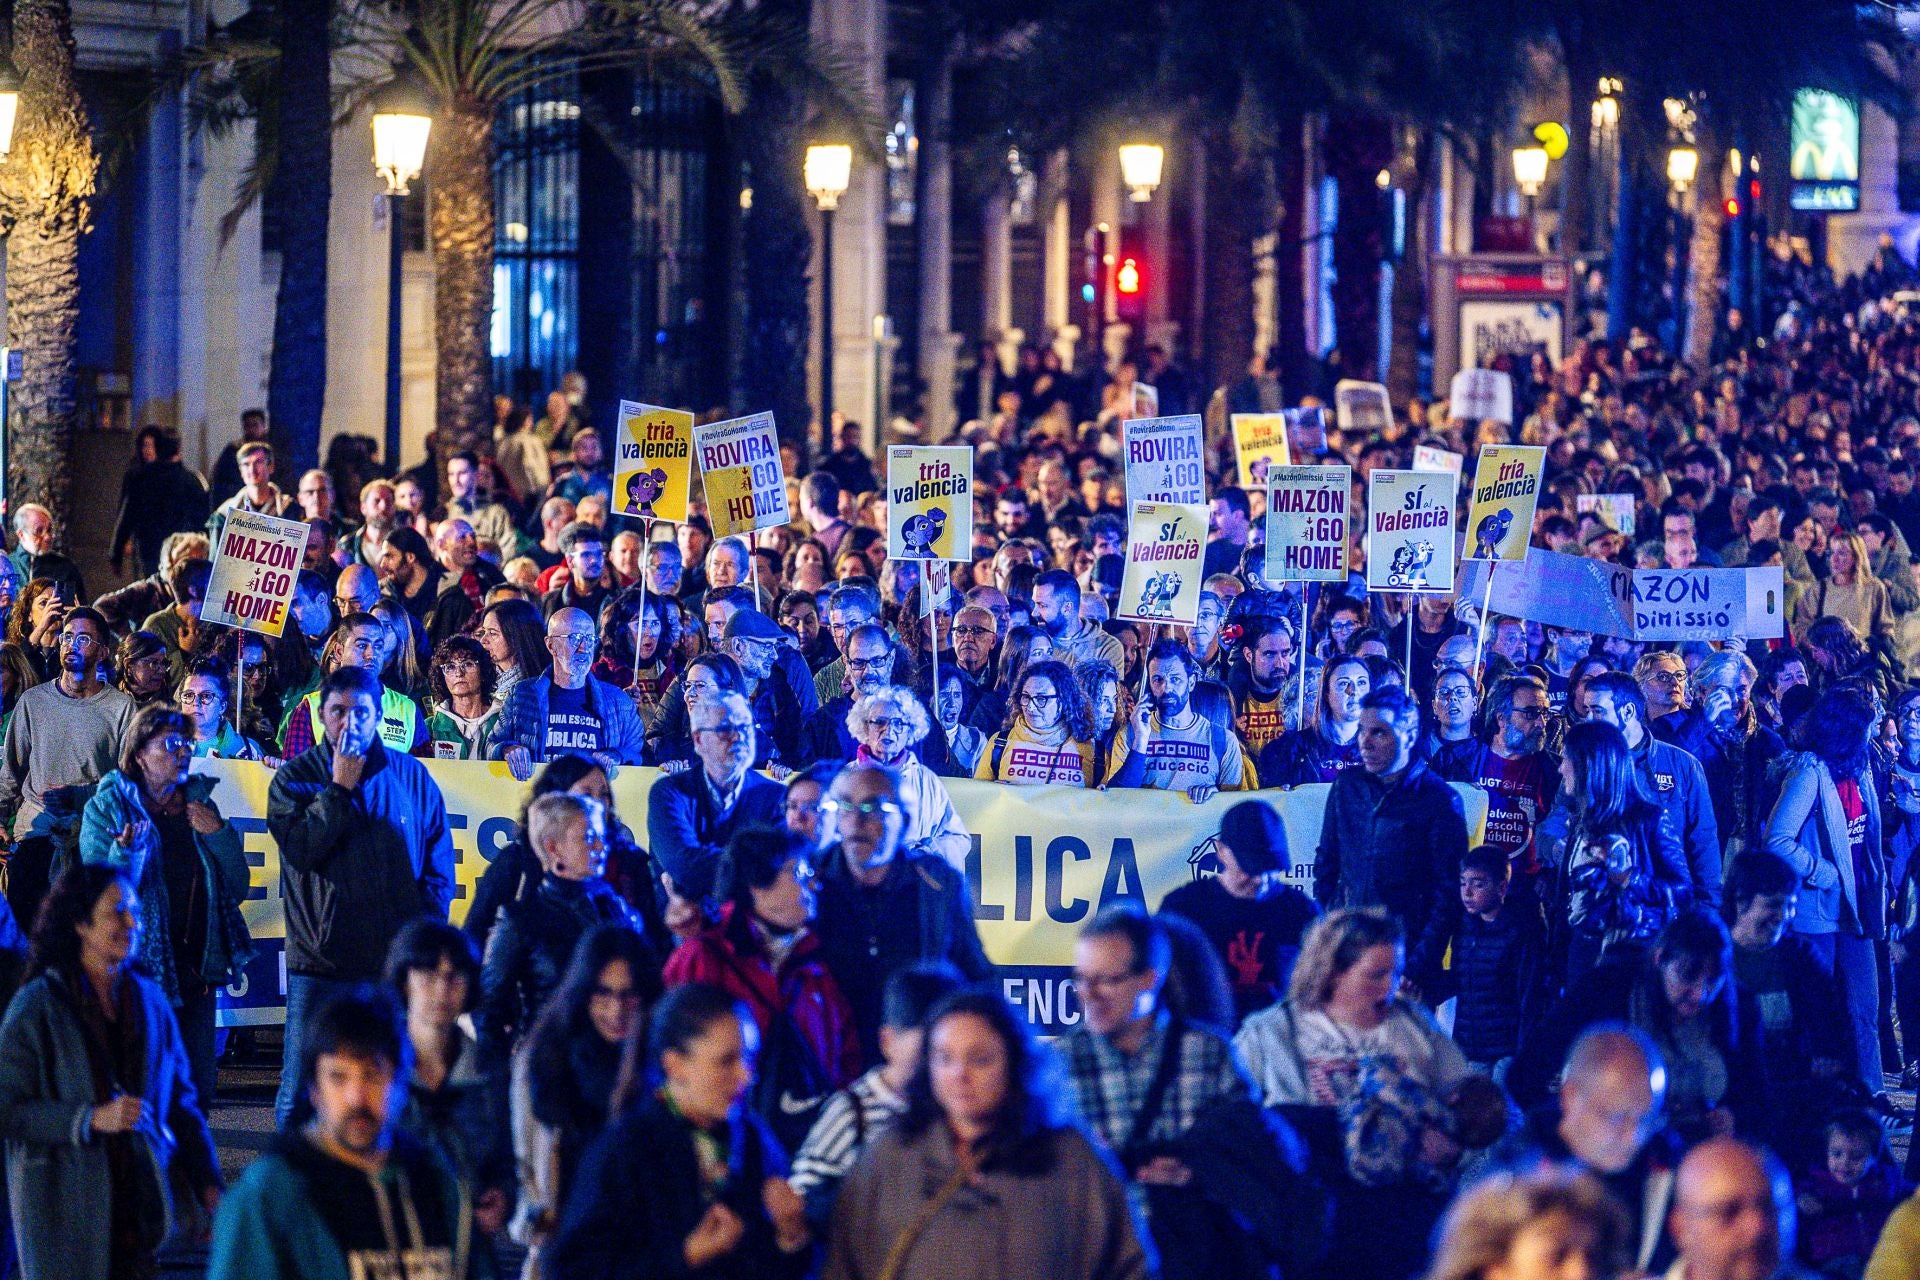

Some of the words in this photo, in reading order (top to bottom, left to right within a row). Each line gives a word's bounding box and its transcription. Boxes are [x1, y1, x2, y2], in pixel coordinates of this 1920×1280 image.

[647, 421, 675, 441] tria
[622, 438, 688, 459] valencià
[703, 434, 775, 471] ROVIRA
[1129, 435, 1199, 464] ROVIRA
[752, 461, 779, 488] GO
[919, 459, 951, 482] tria
[1175, 463, 1199, 487] GO
[1498, 458, 1525, 482] tria
[893, 473, 967, 504] valencià
[1273, 485, 1344, 513] MAZÓN
[1477, 474, 1536, 504] valencià
[727, 488, 784, 522] HOME
[1316, 518, 1344, 542] GO
[1375, 506, 1449, 533] Valencià
[224, 533, 299, 571] MAZÓN
[1132, 539, 1200, 562] Valencià
[1285, 545, 1343, 570] HOME
[261, 571, 291, 597] GO
[1611, 571, 1710, 603] MAZÓN
[223, 590, 284, 625] HOME
[386, 726, 407, 736] STEPV
[549, 714, 567, 724] UNA
[569, 714, 601, 729] ESCOLA
[1008, 767, 1083, 783] educació
[1479, 777, 1502, 787] UGT
